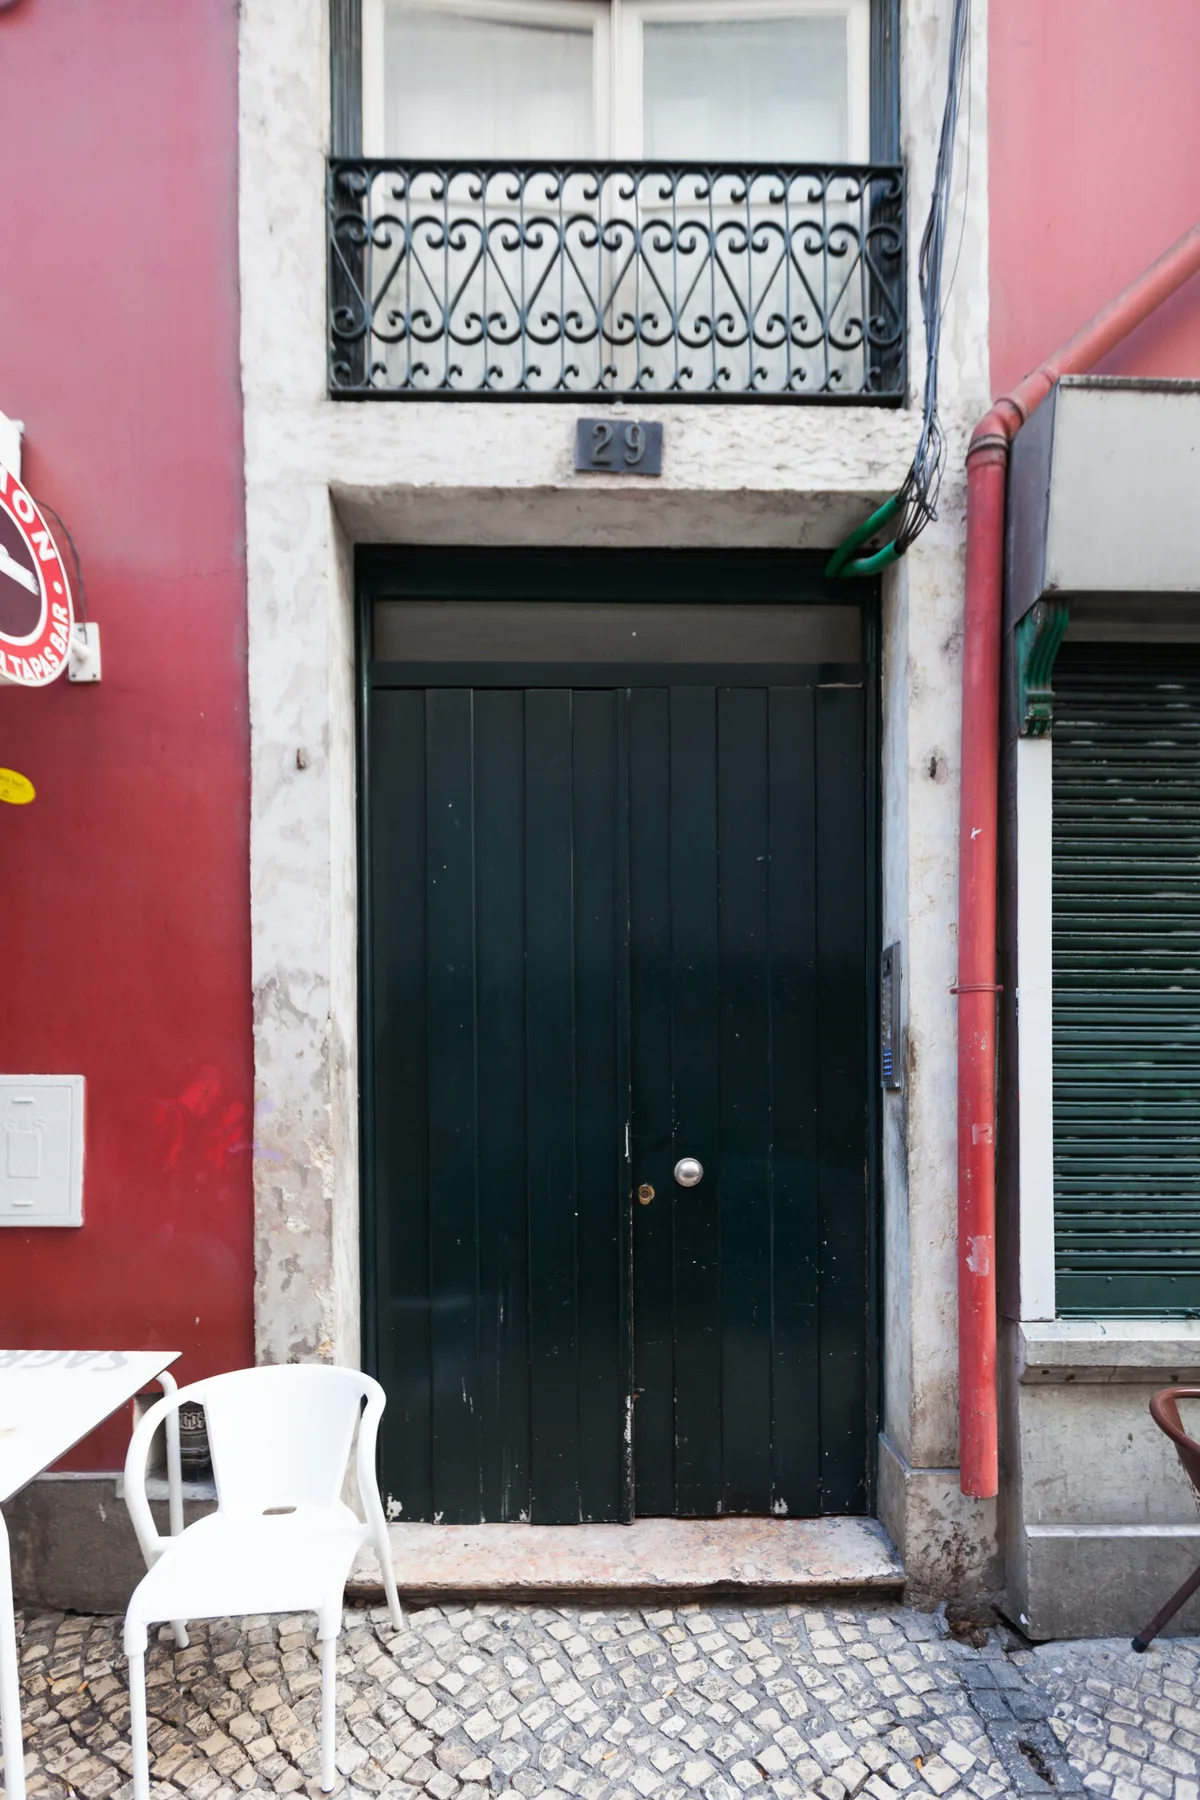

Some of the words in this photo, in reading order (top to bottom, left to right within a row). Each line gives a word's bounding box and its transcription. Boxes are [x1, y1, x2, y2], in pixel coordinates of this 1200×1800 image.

[592, 422, 646, 465] 29
[8, 646, 60, 681] TAPAS
[49, 602, 69, 656] BAR
